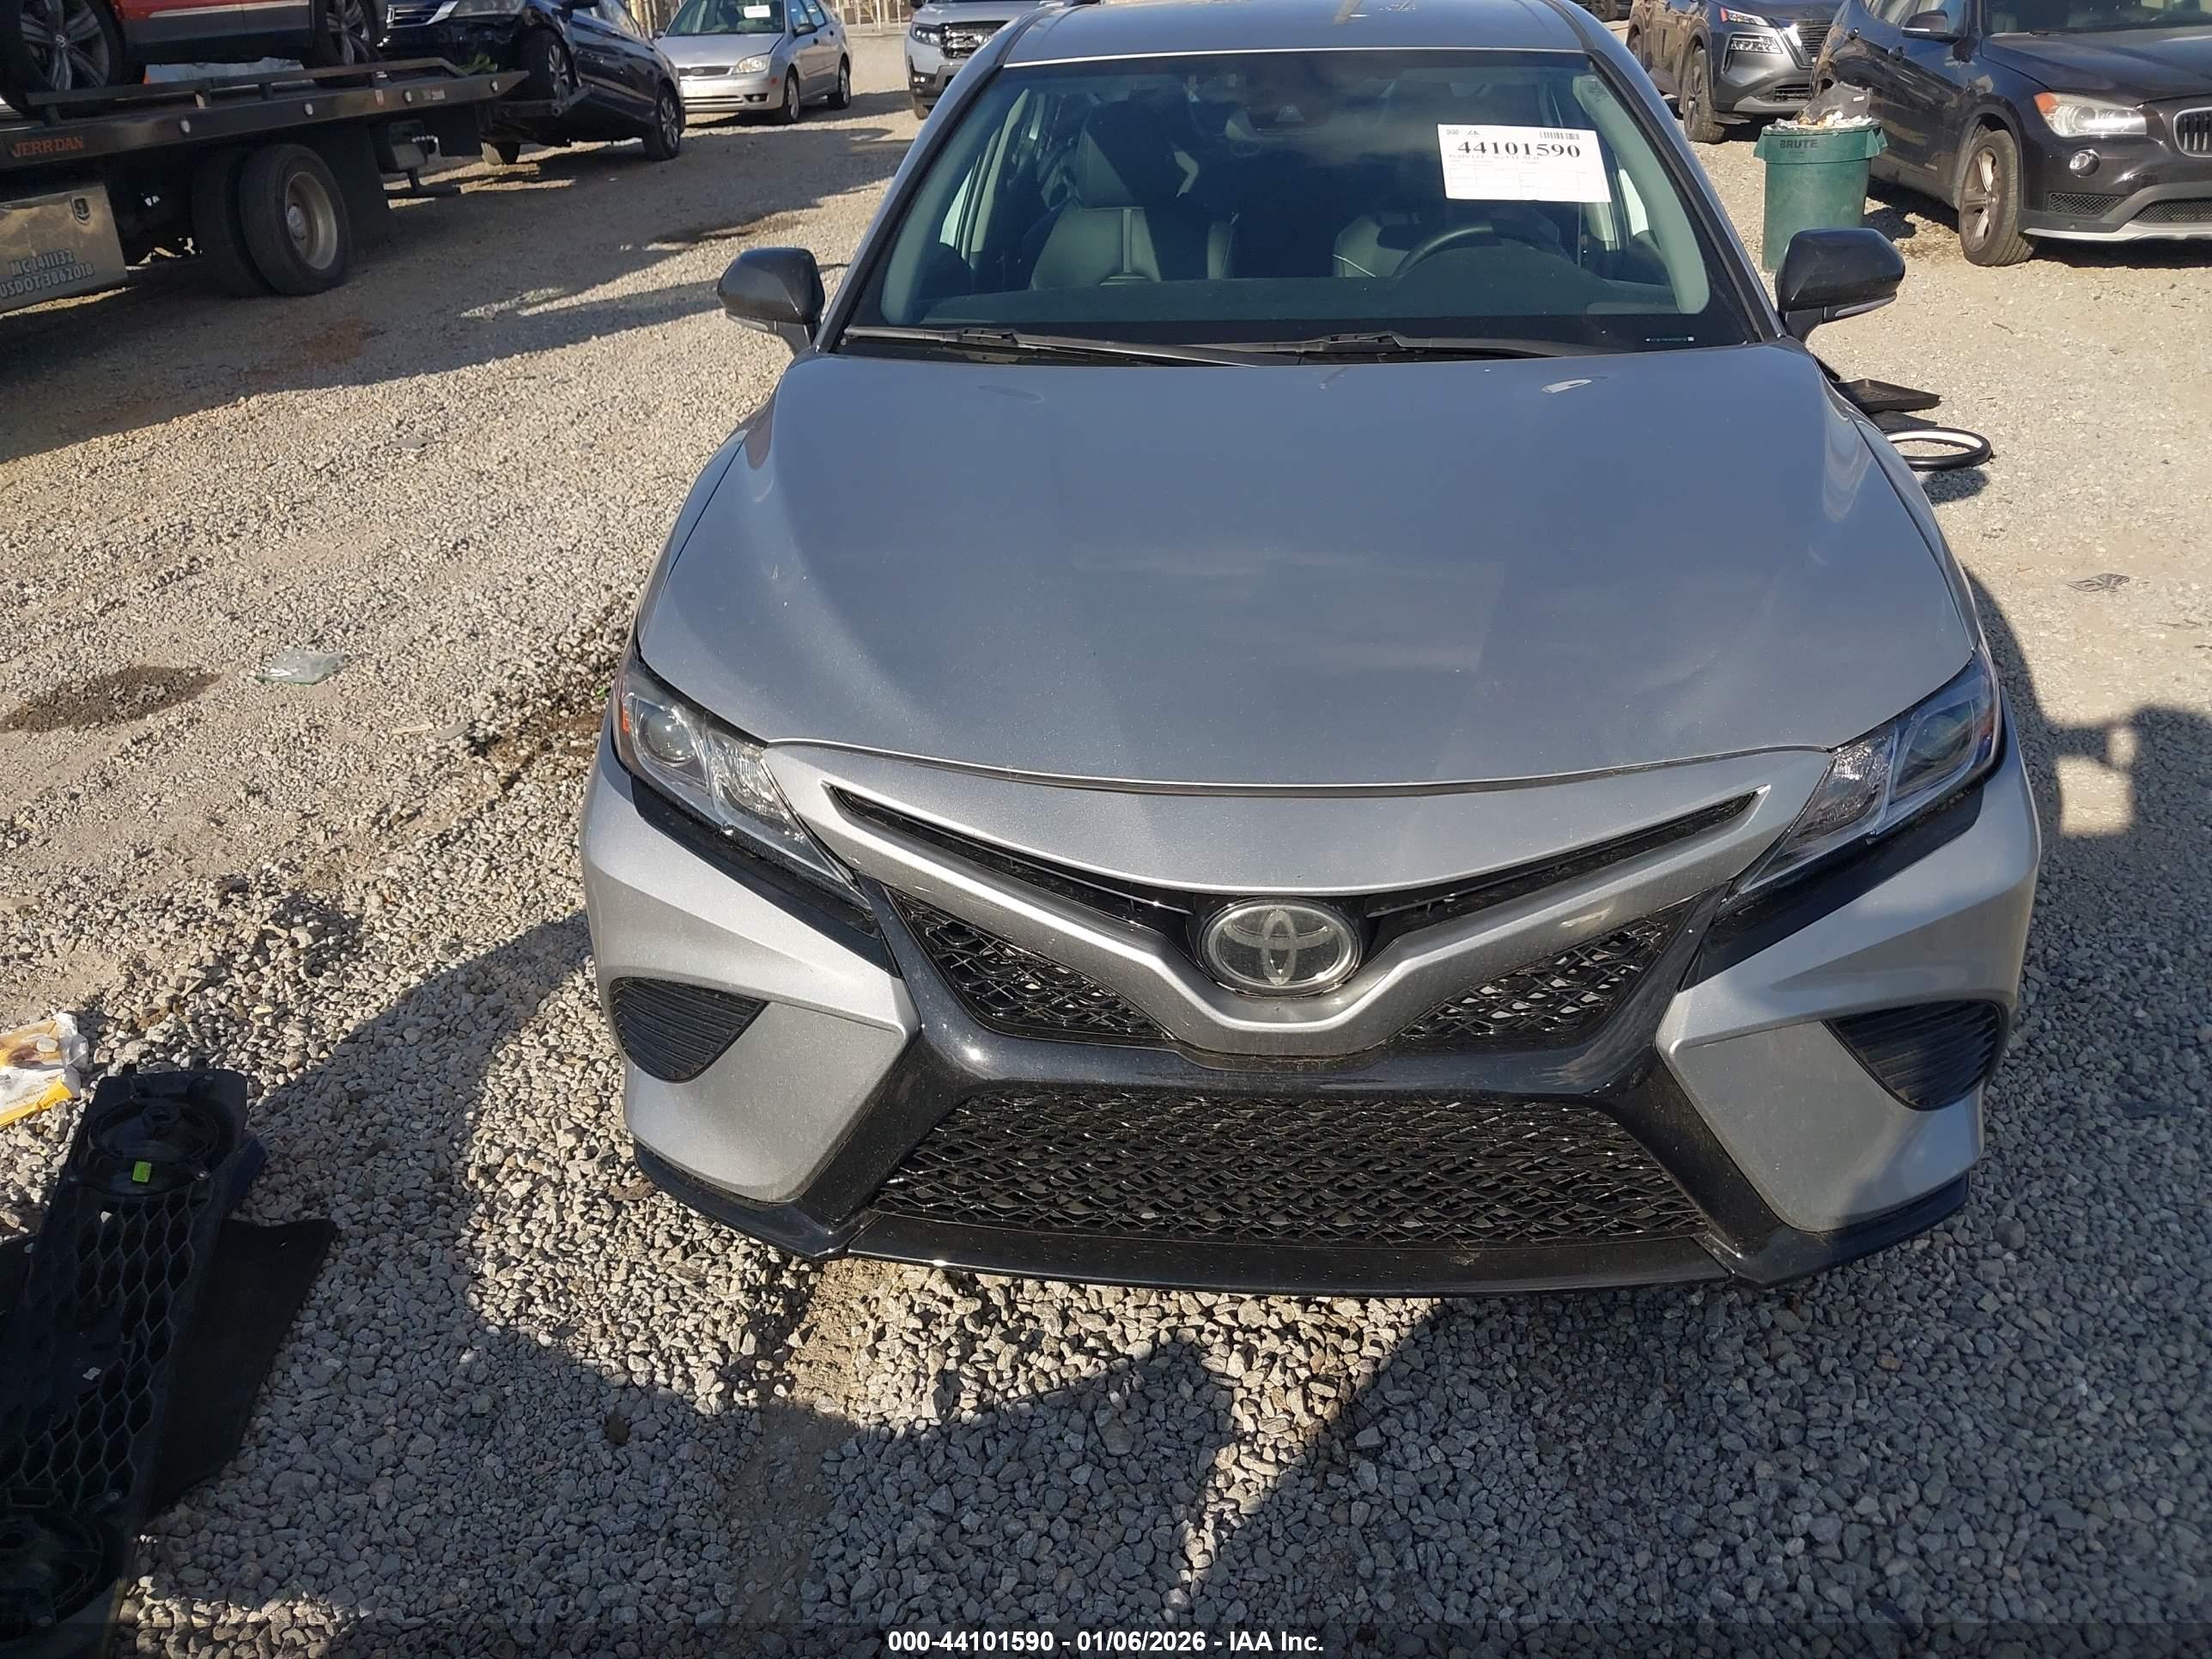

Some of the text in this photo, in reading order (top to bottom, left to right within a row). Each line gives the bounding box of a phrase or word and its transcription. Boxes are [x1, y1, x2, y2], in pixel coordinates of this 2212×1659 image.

[1457, 141, 1581, 158] 44101590
[1779, 138, 1820, 149] BRUTE
[10, 259, 30, 276] MC
